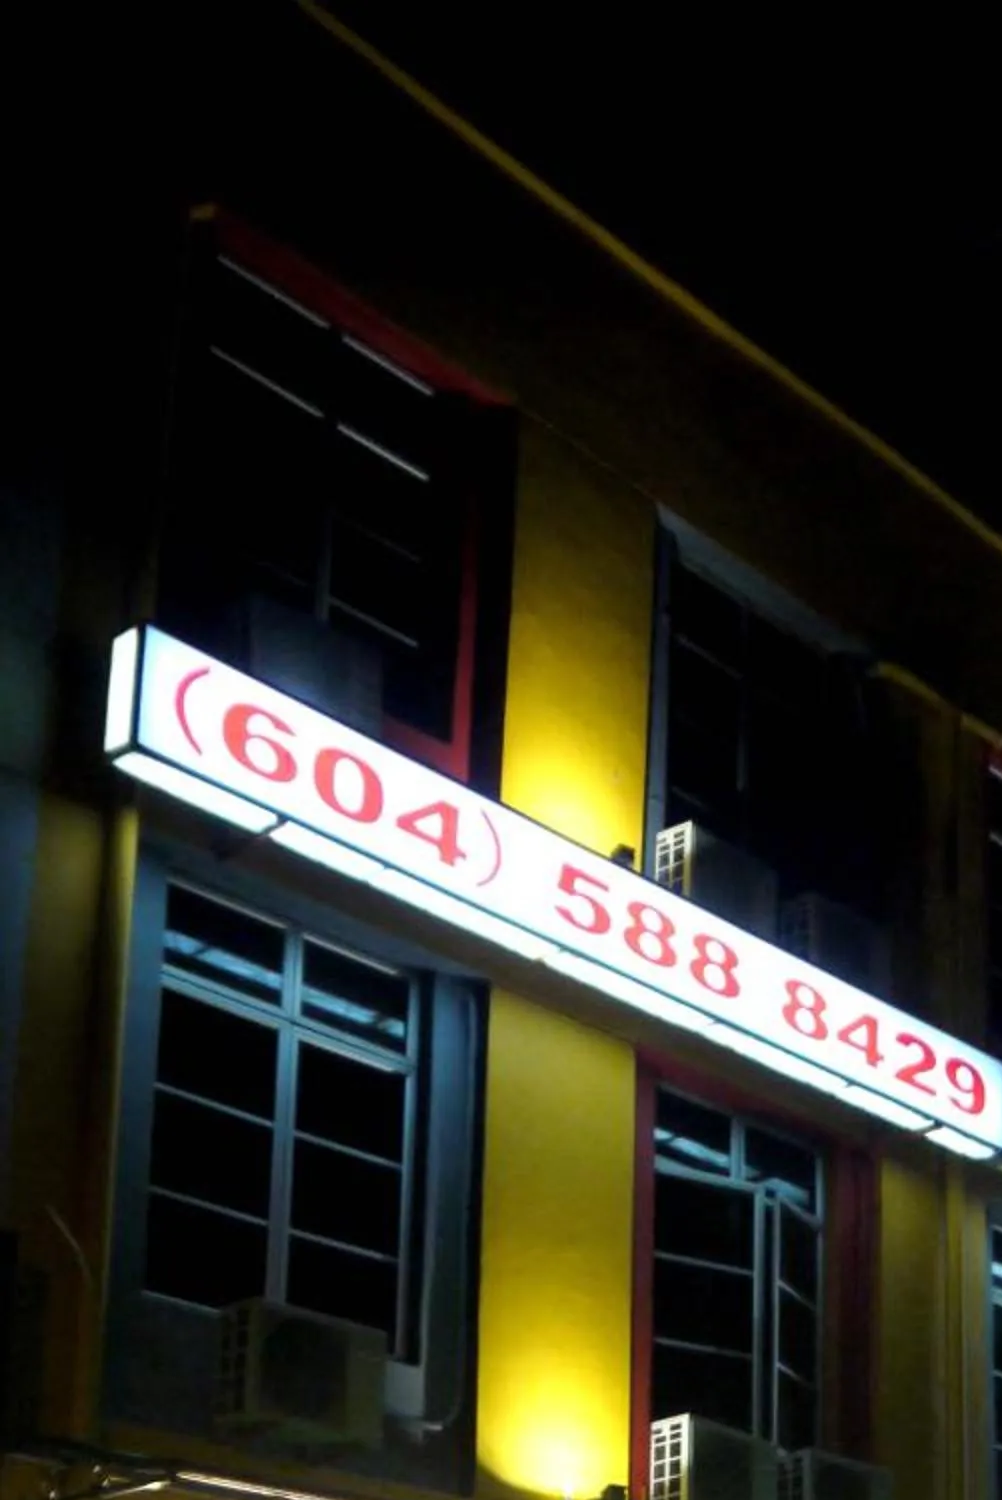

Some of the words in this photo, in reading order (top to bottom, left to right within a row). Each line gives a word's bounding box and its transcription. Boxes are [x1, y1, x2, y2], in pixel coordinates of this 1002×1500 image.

[174, 667, 504, 888] (604)
[556, 864, 741, 999] 588
[781, 979, 988, 1117] 8429
